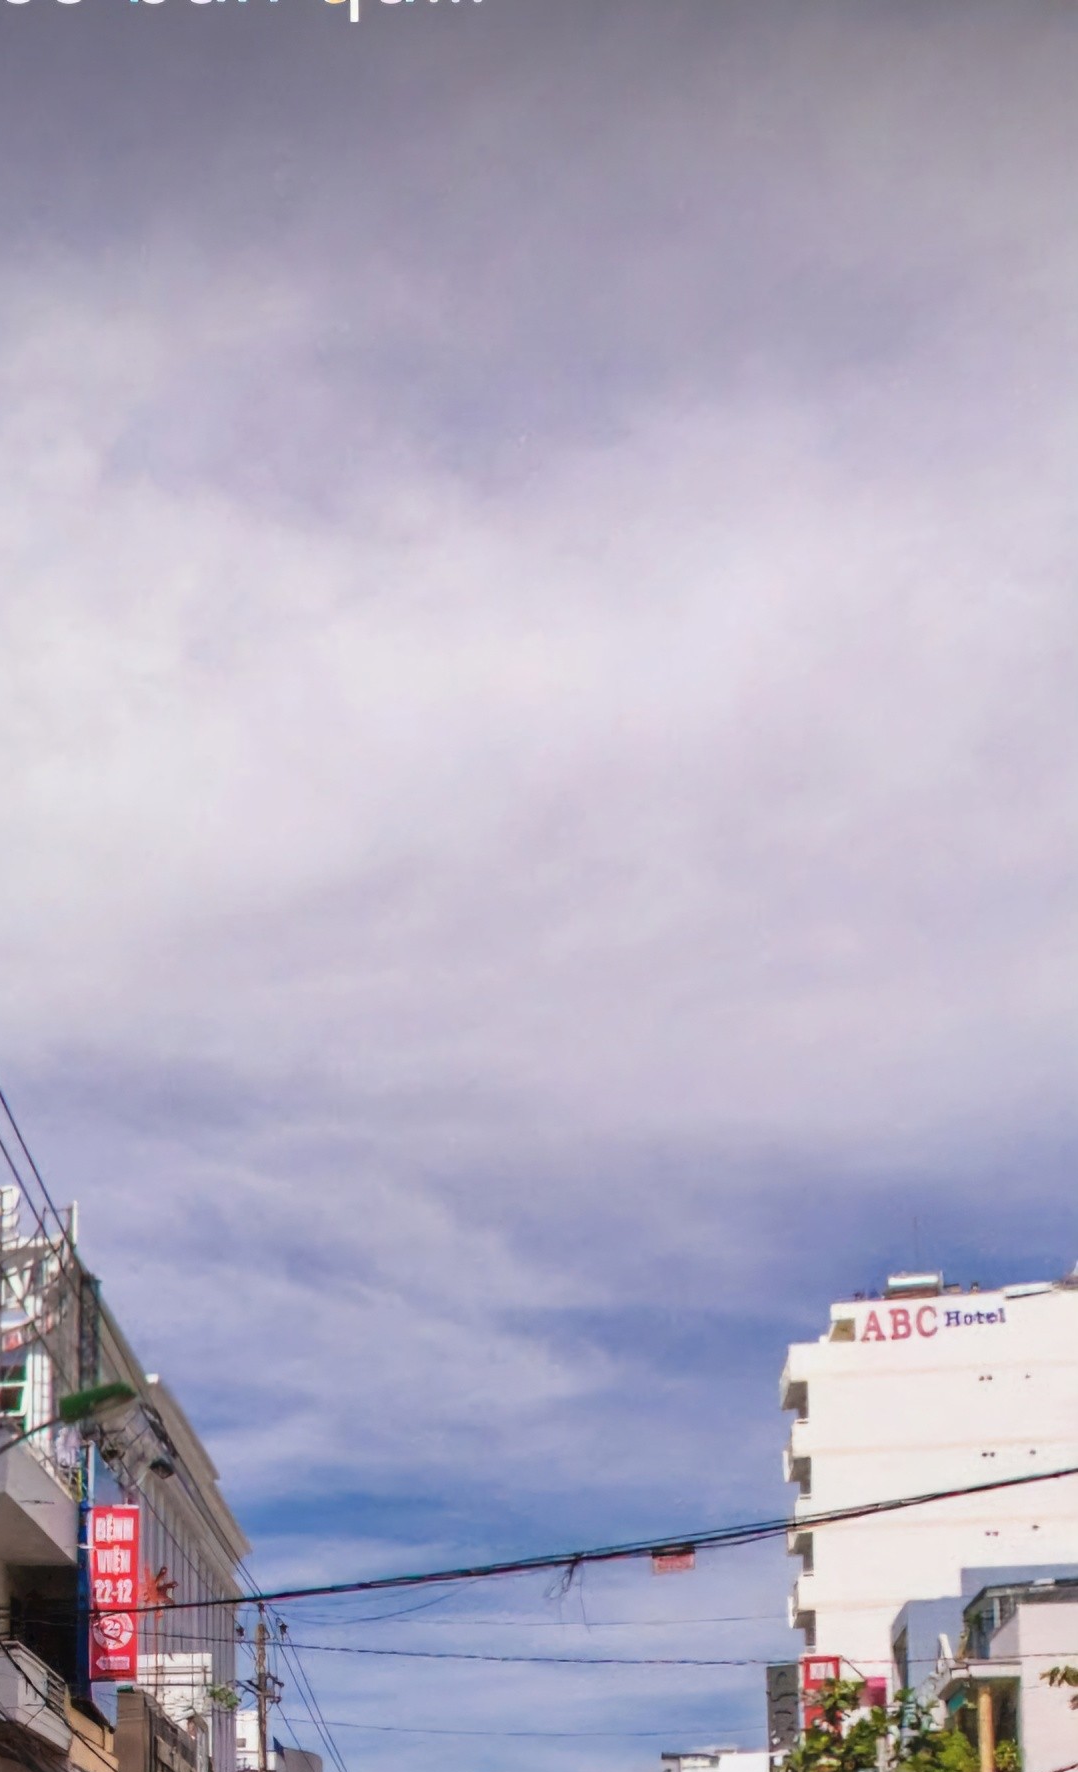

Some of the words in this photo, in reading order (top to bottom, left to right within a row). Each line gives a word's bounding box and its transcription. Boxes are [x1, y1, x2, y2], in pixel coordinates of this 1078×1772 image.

[860, 1305, 938, 1342] ABC
[944, 1307, 1006, 1328] Hotel
[95, 1514, 134, 1543] BỆNH
[95, 1579, 134, 1603] 22-12
